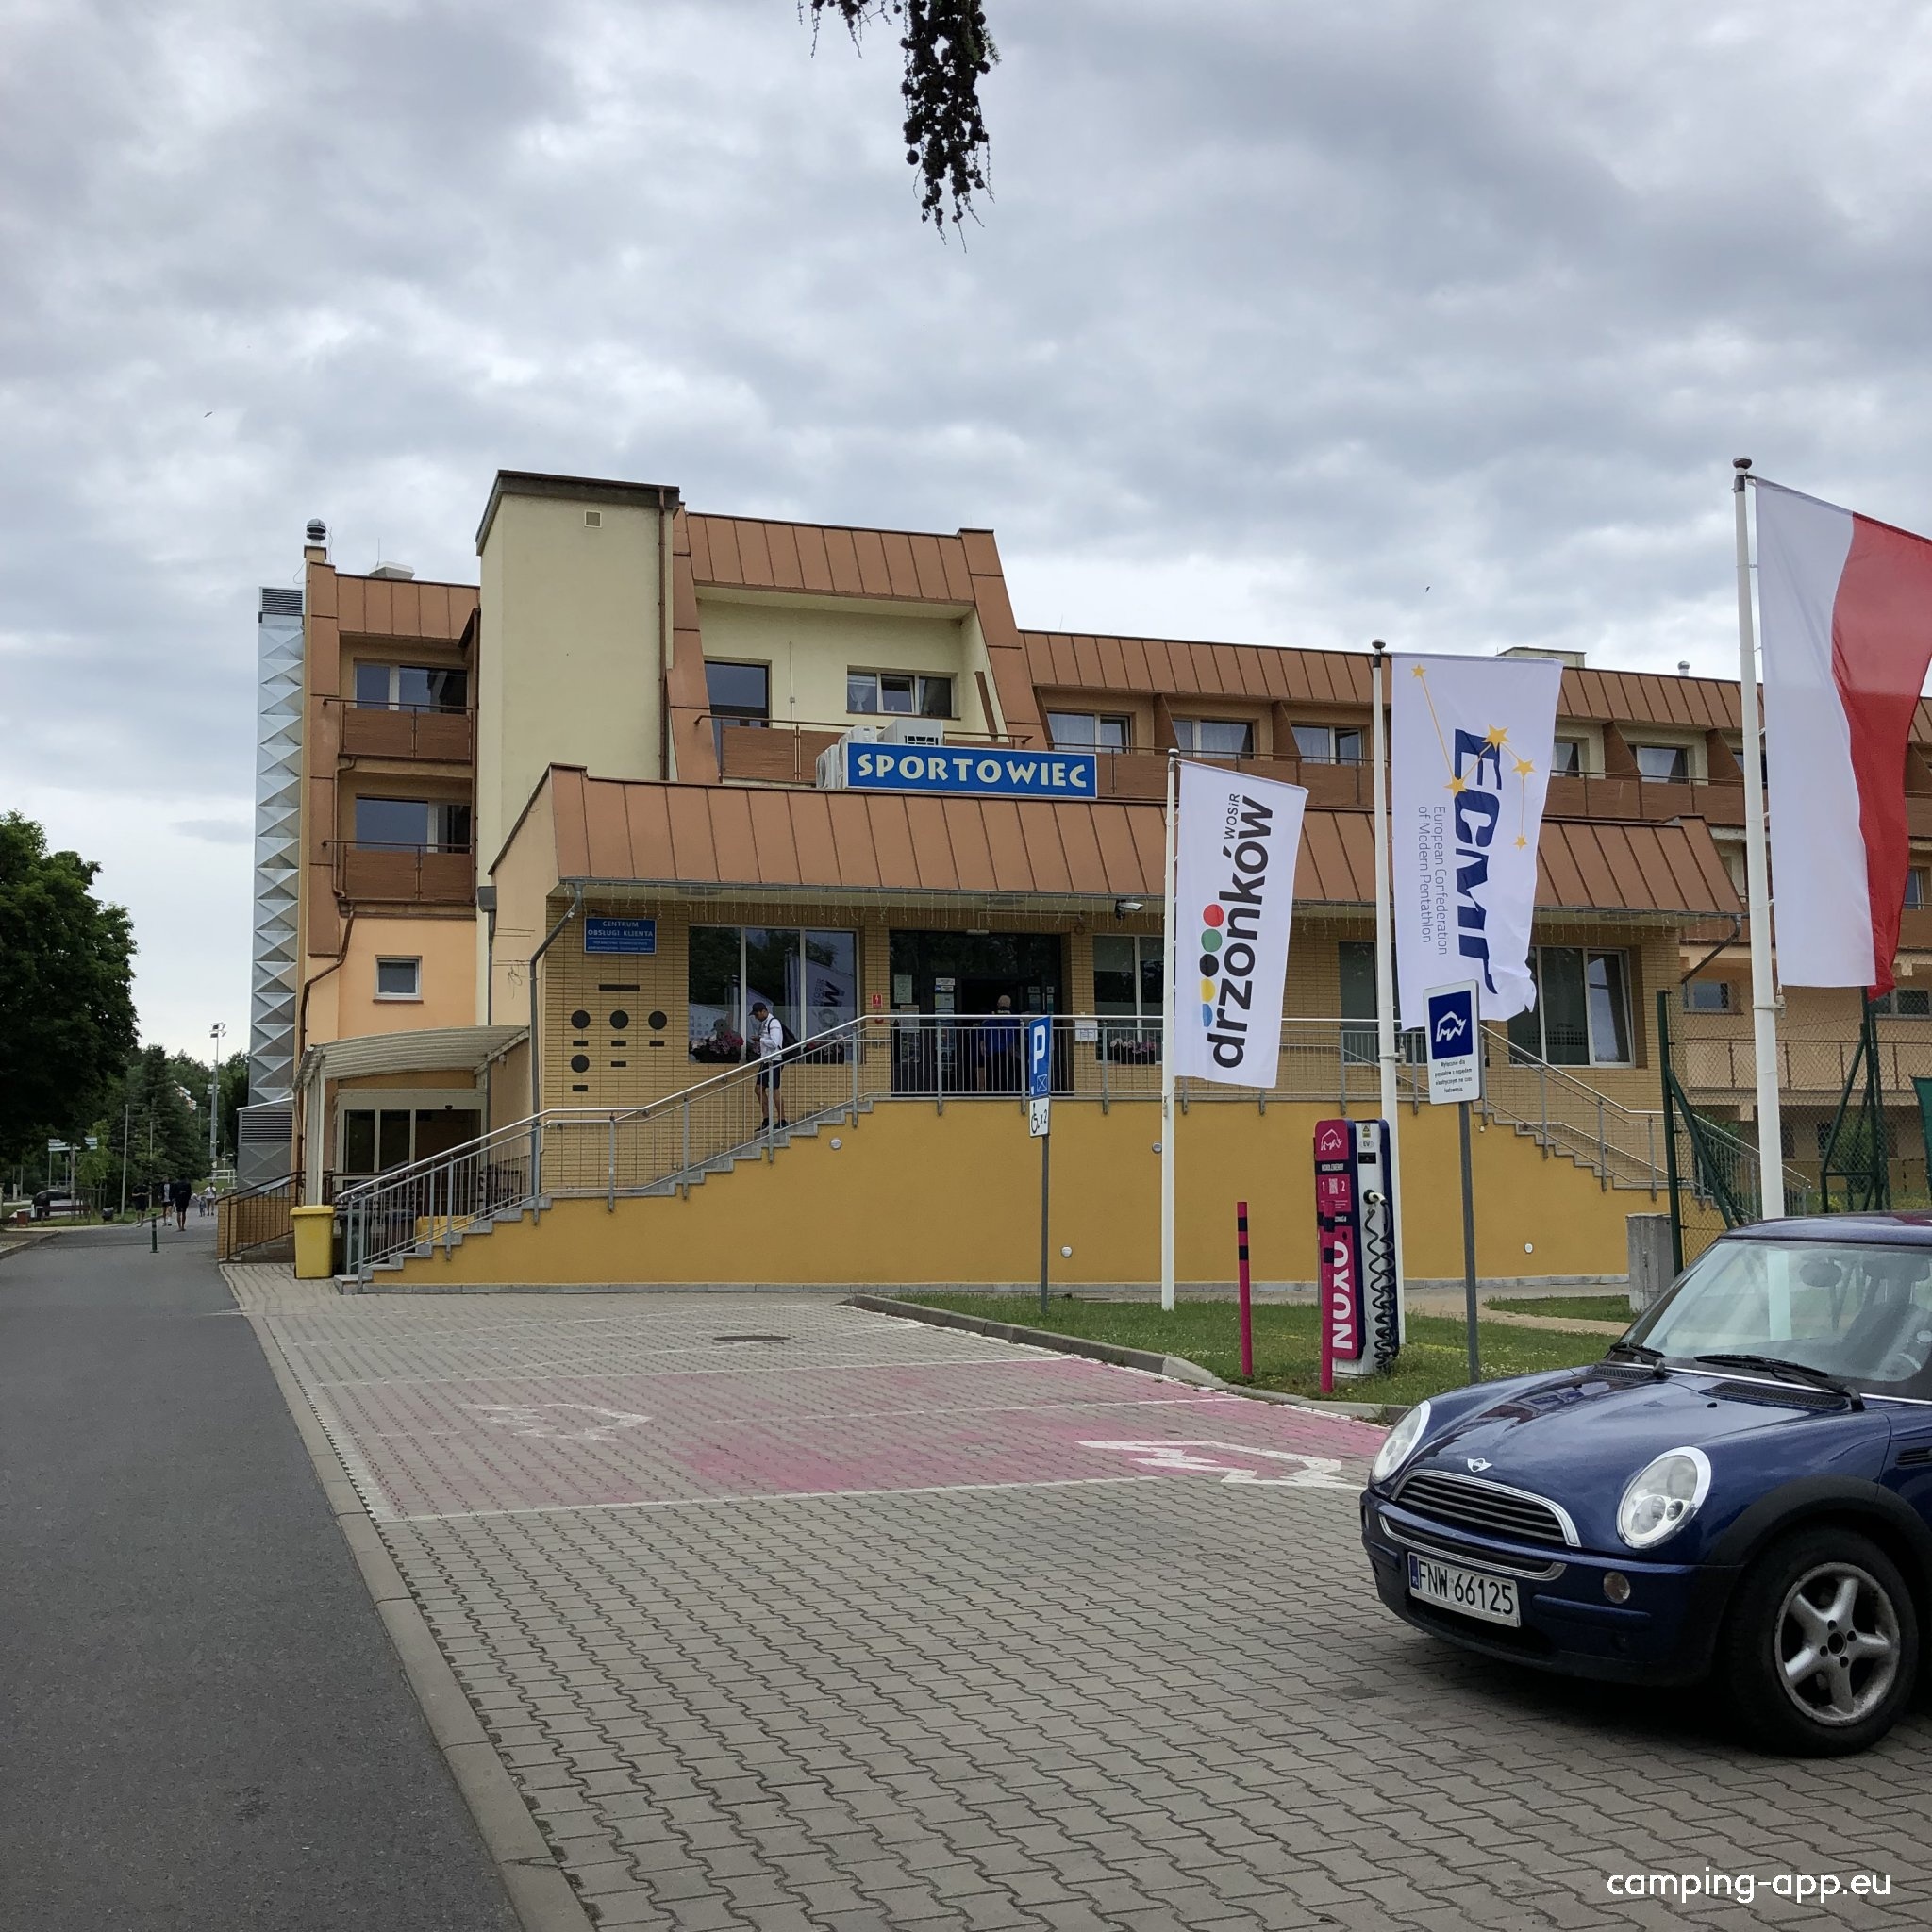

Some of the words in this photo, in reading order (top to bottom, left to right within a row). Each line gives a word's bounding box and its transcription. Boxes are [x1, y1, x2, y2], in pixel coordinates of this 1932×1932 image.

[858, 753, 1087, 788] SPORTOWIEC
[1224, 793, 1241, 840] WOSiR
[1418, 806, 1431, 818] of
[1431, 806, 1446, 865] European
[1418, 823, 1431, 871] Modern
[1208, 795, 1274, 1068] drzonków
[1419, 874, 1434, 943] Pentathlon
[1434, 869, 1448, 956] Confederation
[1033, 1024, 1046, 1074] P
[1418, 1560, 1448, 1598] FNW
[1454, 1573, 1514, 1615] 66125
